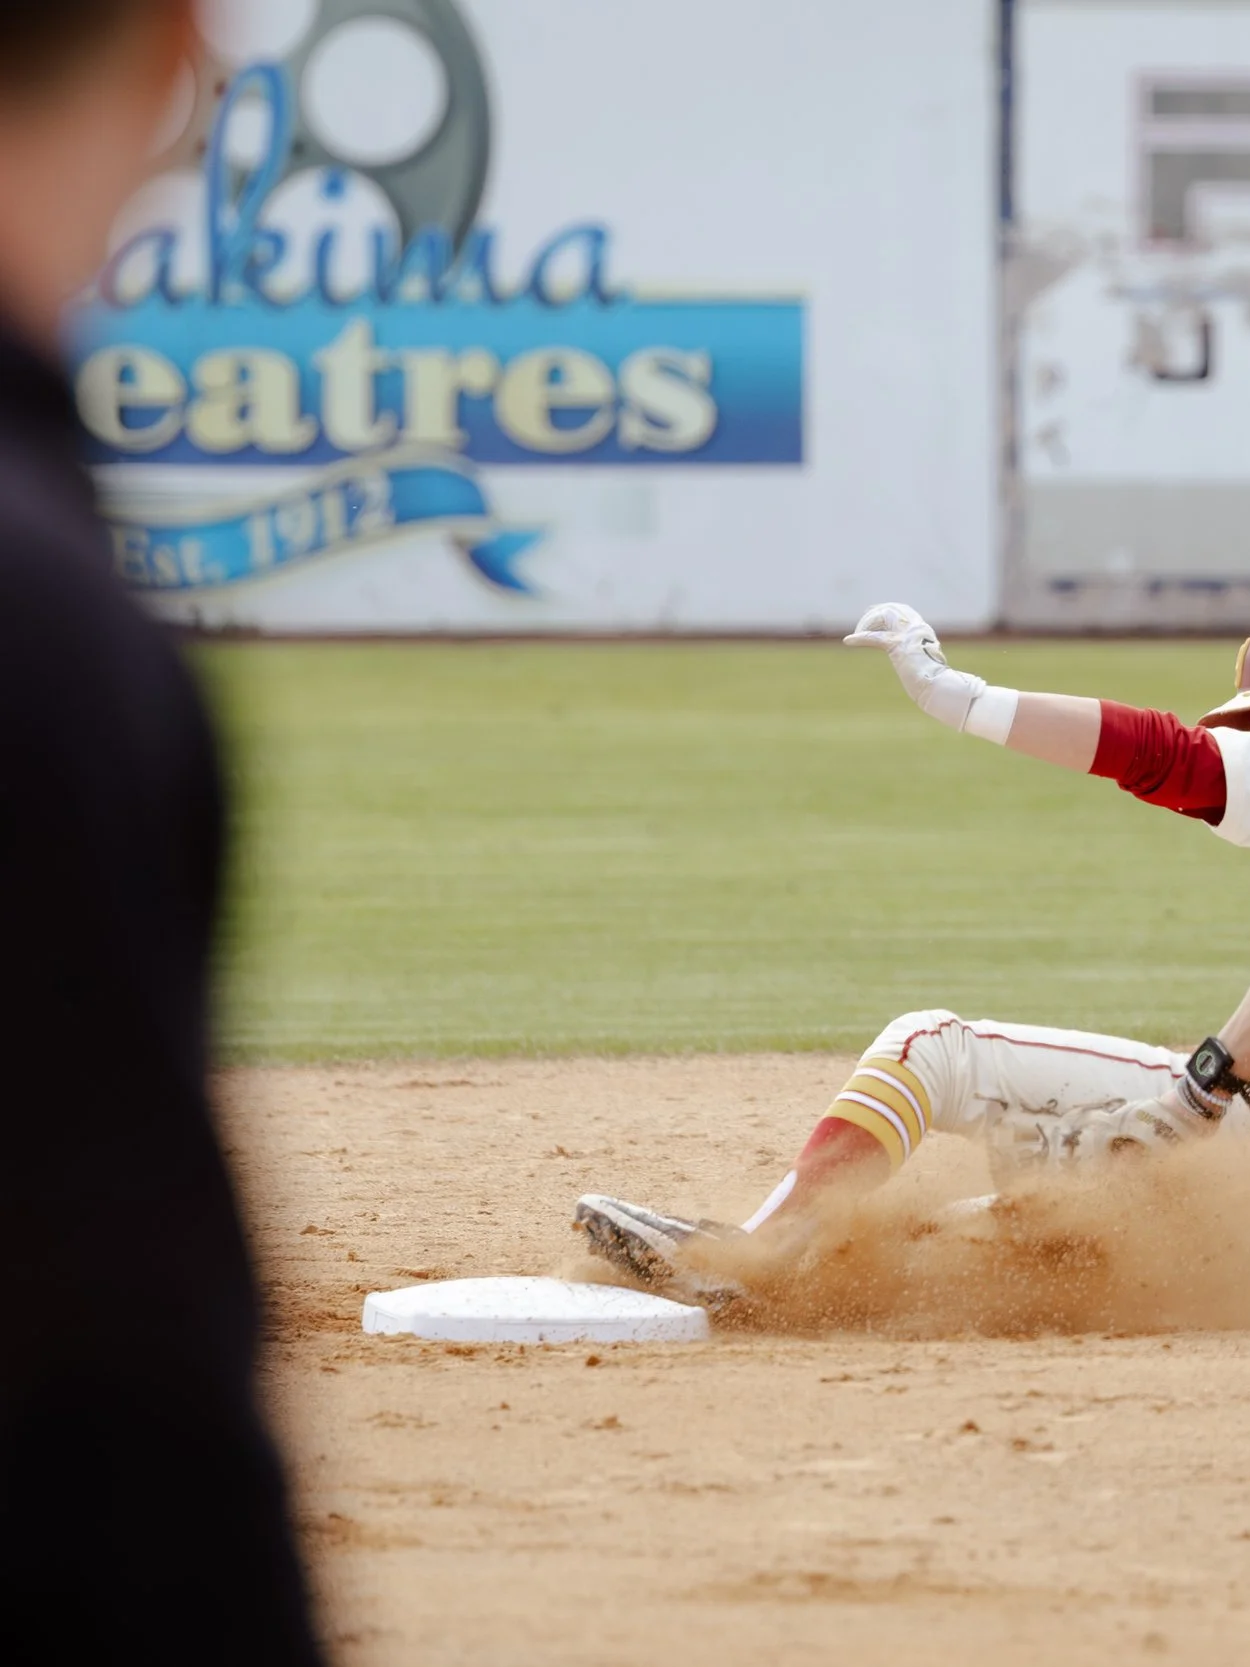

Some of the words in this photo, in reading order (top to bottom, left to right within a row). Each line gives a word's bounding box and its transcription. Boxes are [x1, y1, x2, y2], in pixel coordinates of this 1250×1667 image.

[98, 60, 628, 308] akima
[75, 318, 718, 455] eatres
[250, 472, 394, 572] 1912
